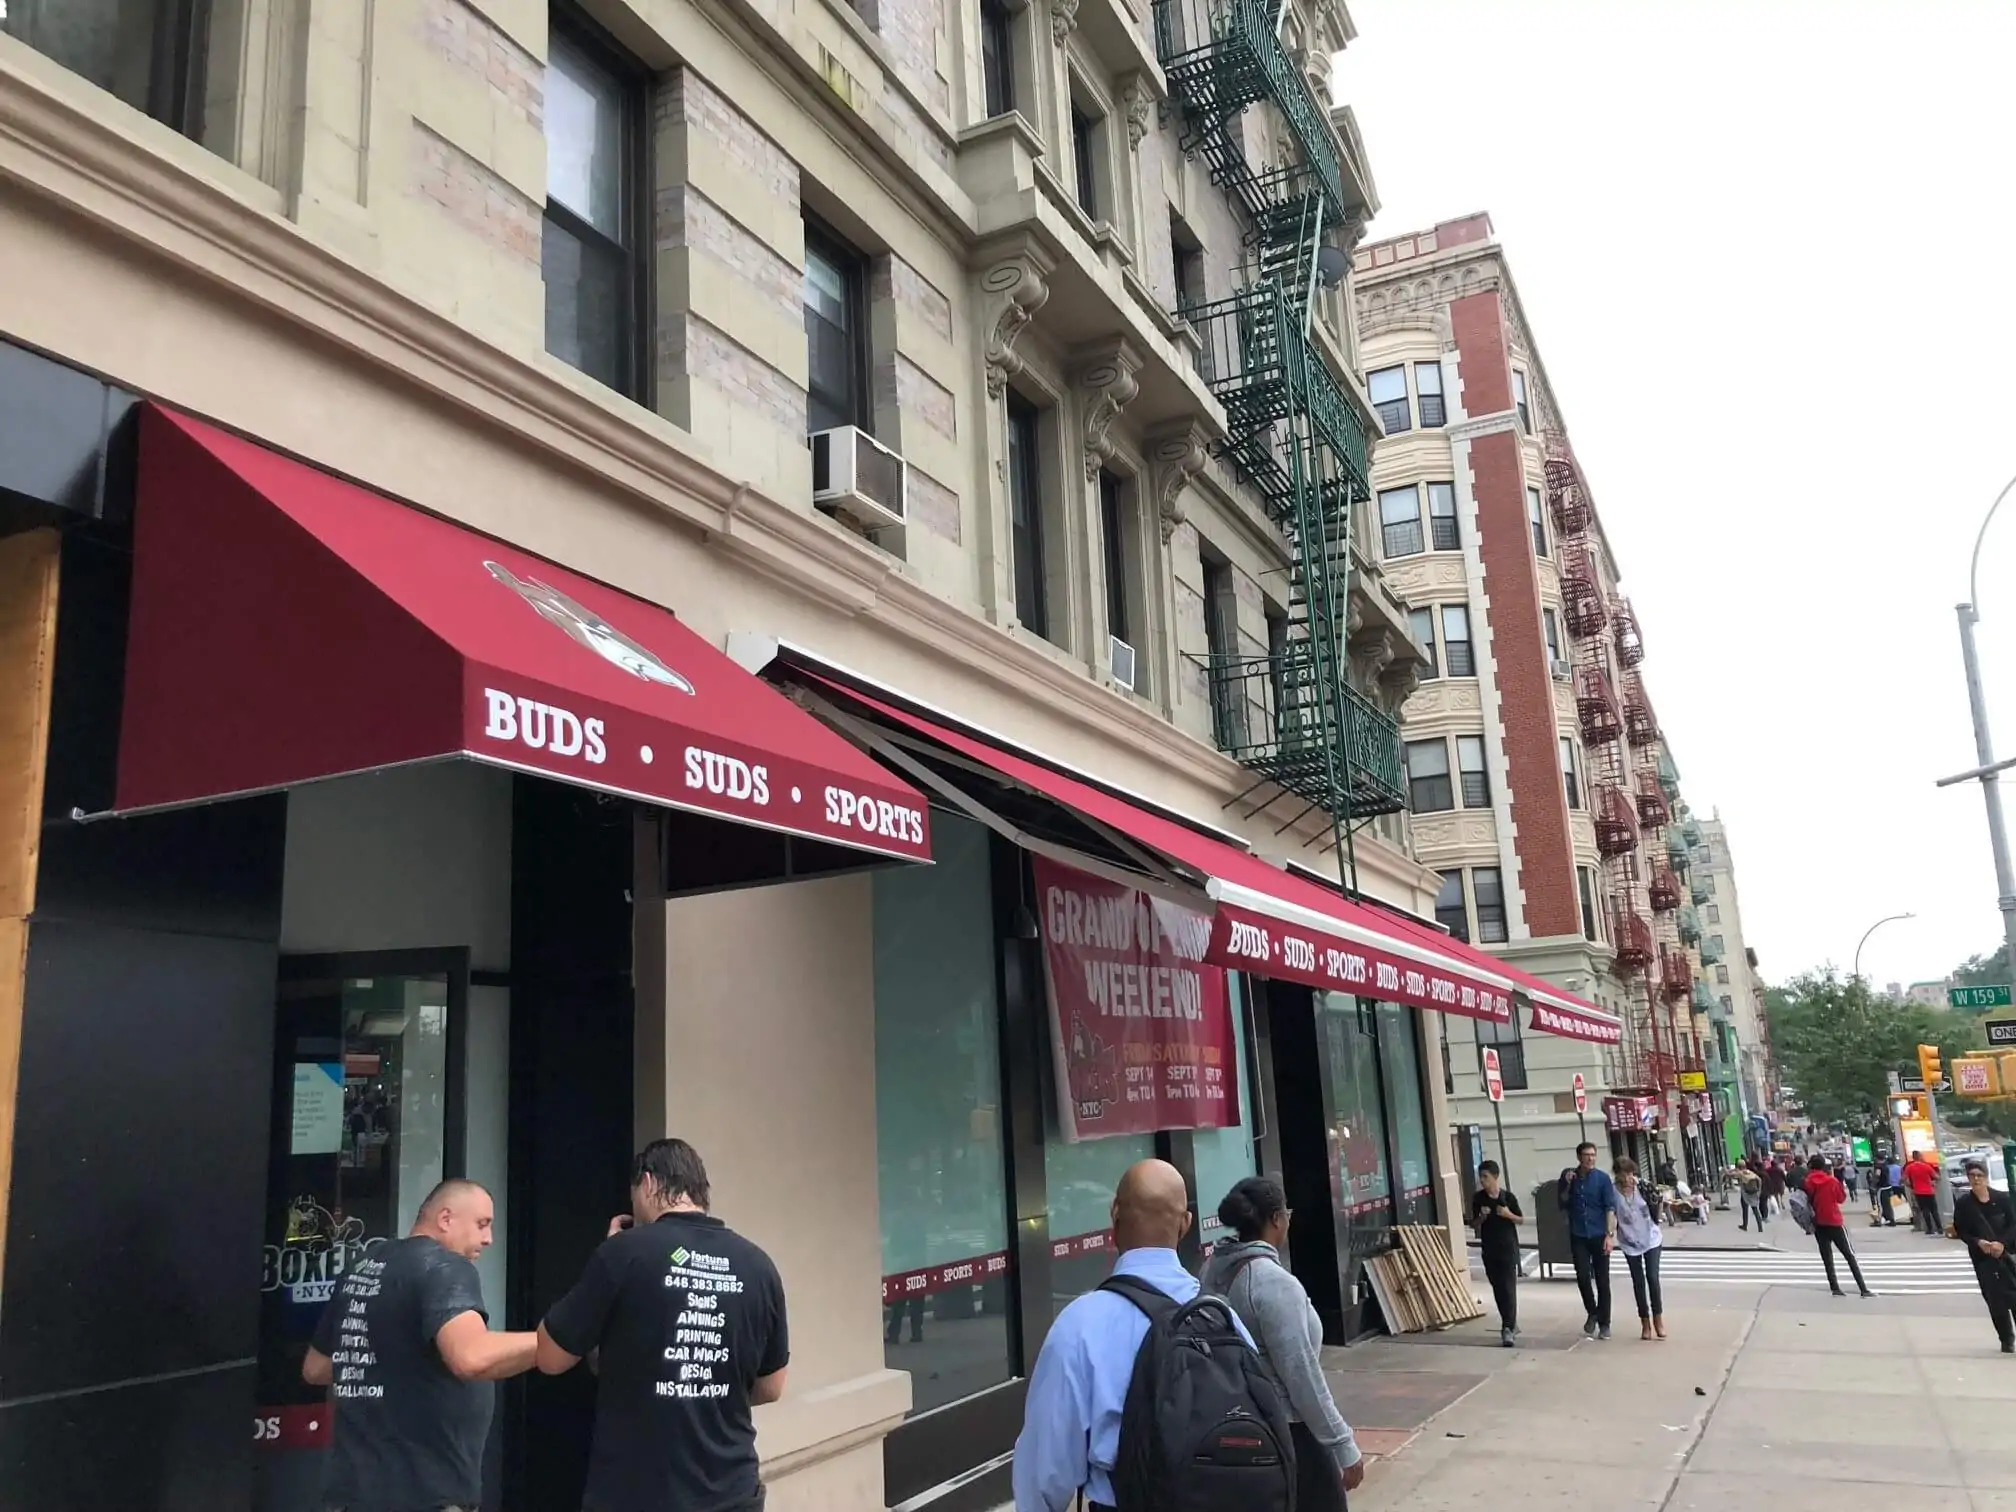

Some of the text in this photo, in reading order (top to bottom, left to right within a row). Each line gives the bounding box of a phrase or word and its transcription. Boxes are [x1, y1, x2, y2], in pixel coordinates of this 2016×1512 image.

[485, 687, 923, 844] BUDS SUDS SPORTS
[1047, 886, 1130, 950] GRAND
[1227, 920, 1269, 961] BUDS
[1284, 936, 1315, 972] SUDS
[1327, 948, 1365, 983] SPORTS
[1376, 961, 1399, 991] BUDS
[1406, 970, 1425, 997] SUDS
[1431, 977, 1455, 1004] SPORTS
[1955, 990, 1968, 1005] W
[1973, 988, 1995, 1004] 159
[905, 1274, 927, 1291] SUDS
[943, 1263, 973, 1283] SPORTS
[987, 1255, 1007, 1272] BUDS
[687, 1292, 718, 1309] SIGNS
[664, 1347, 690, 1361] CAR
